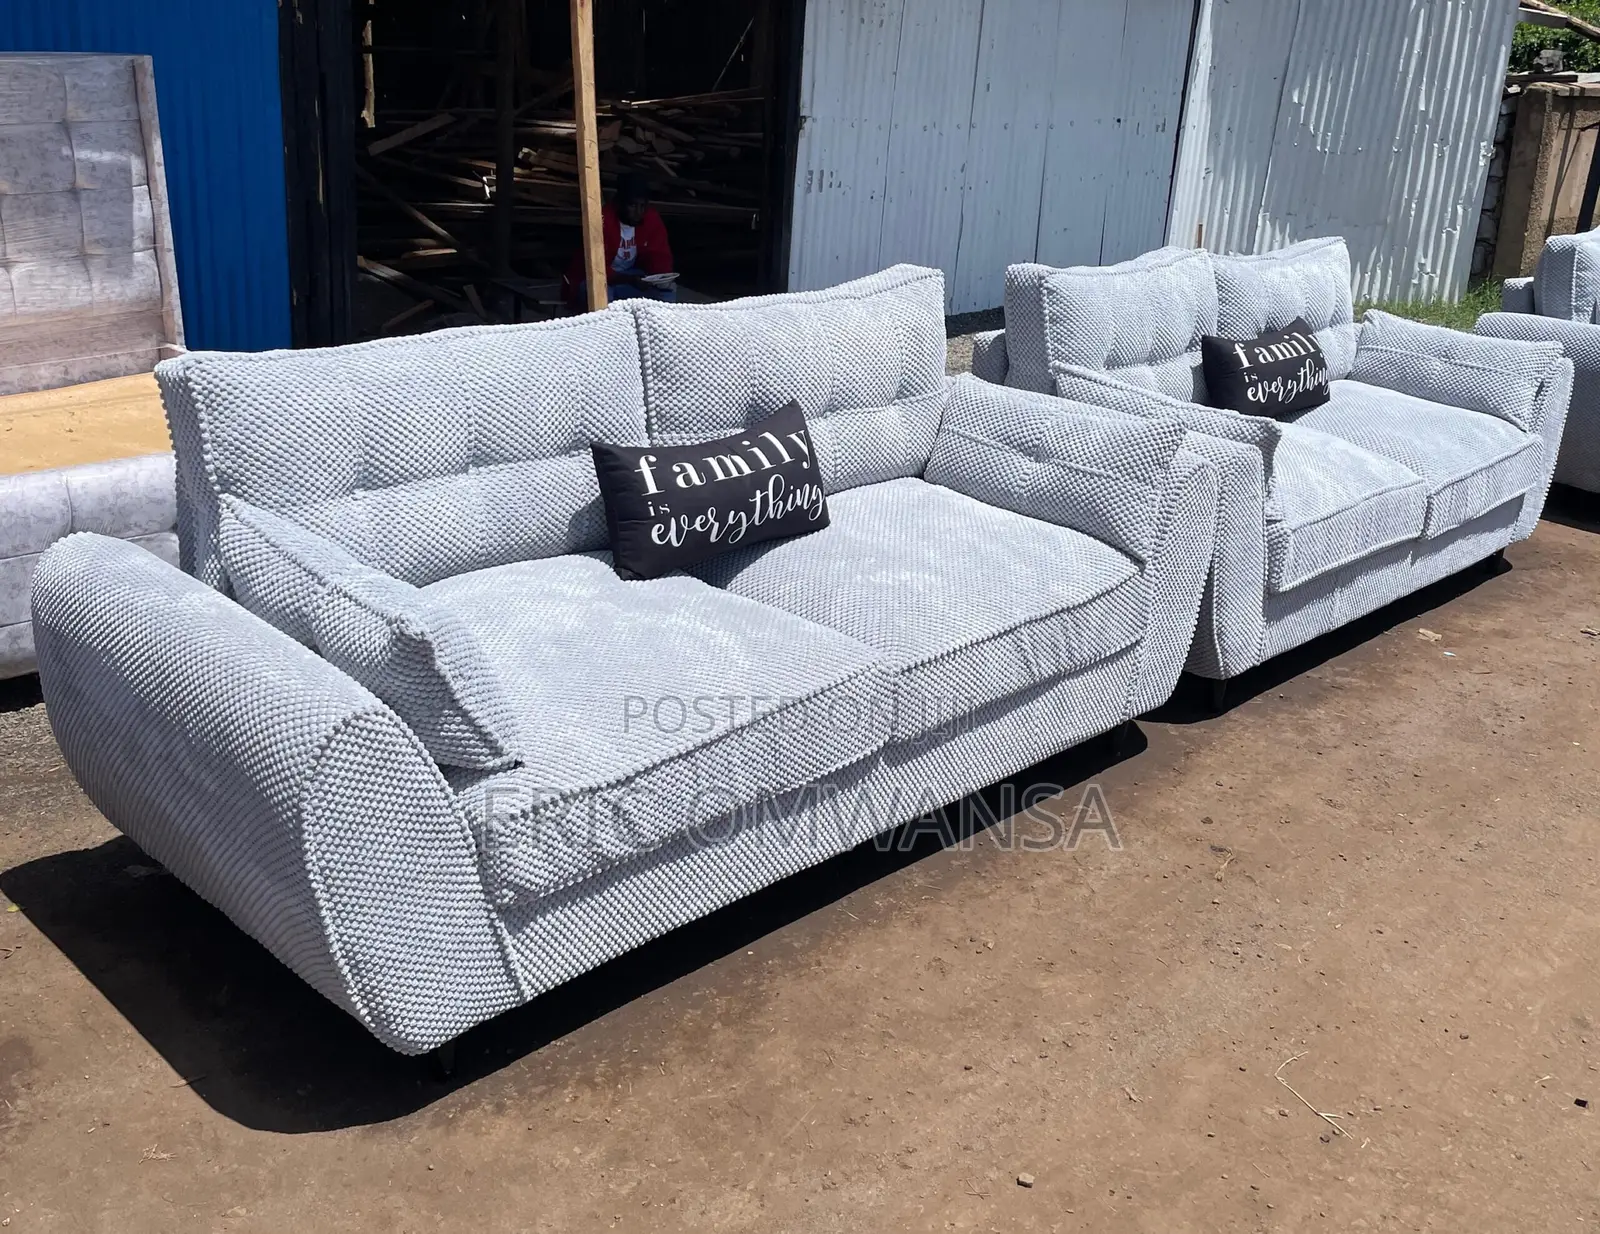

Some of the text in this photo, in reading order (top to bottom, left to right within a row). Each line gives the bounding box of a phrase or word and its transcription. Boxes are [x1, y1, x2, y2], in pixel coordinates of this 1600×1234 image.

[1243, 372, 1258, 383] is
[635, 429, 812, 496] family
[647, 501, 670, 517] is
[651, 474, 825, 548] everything
